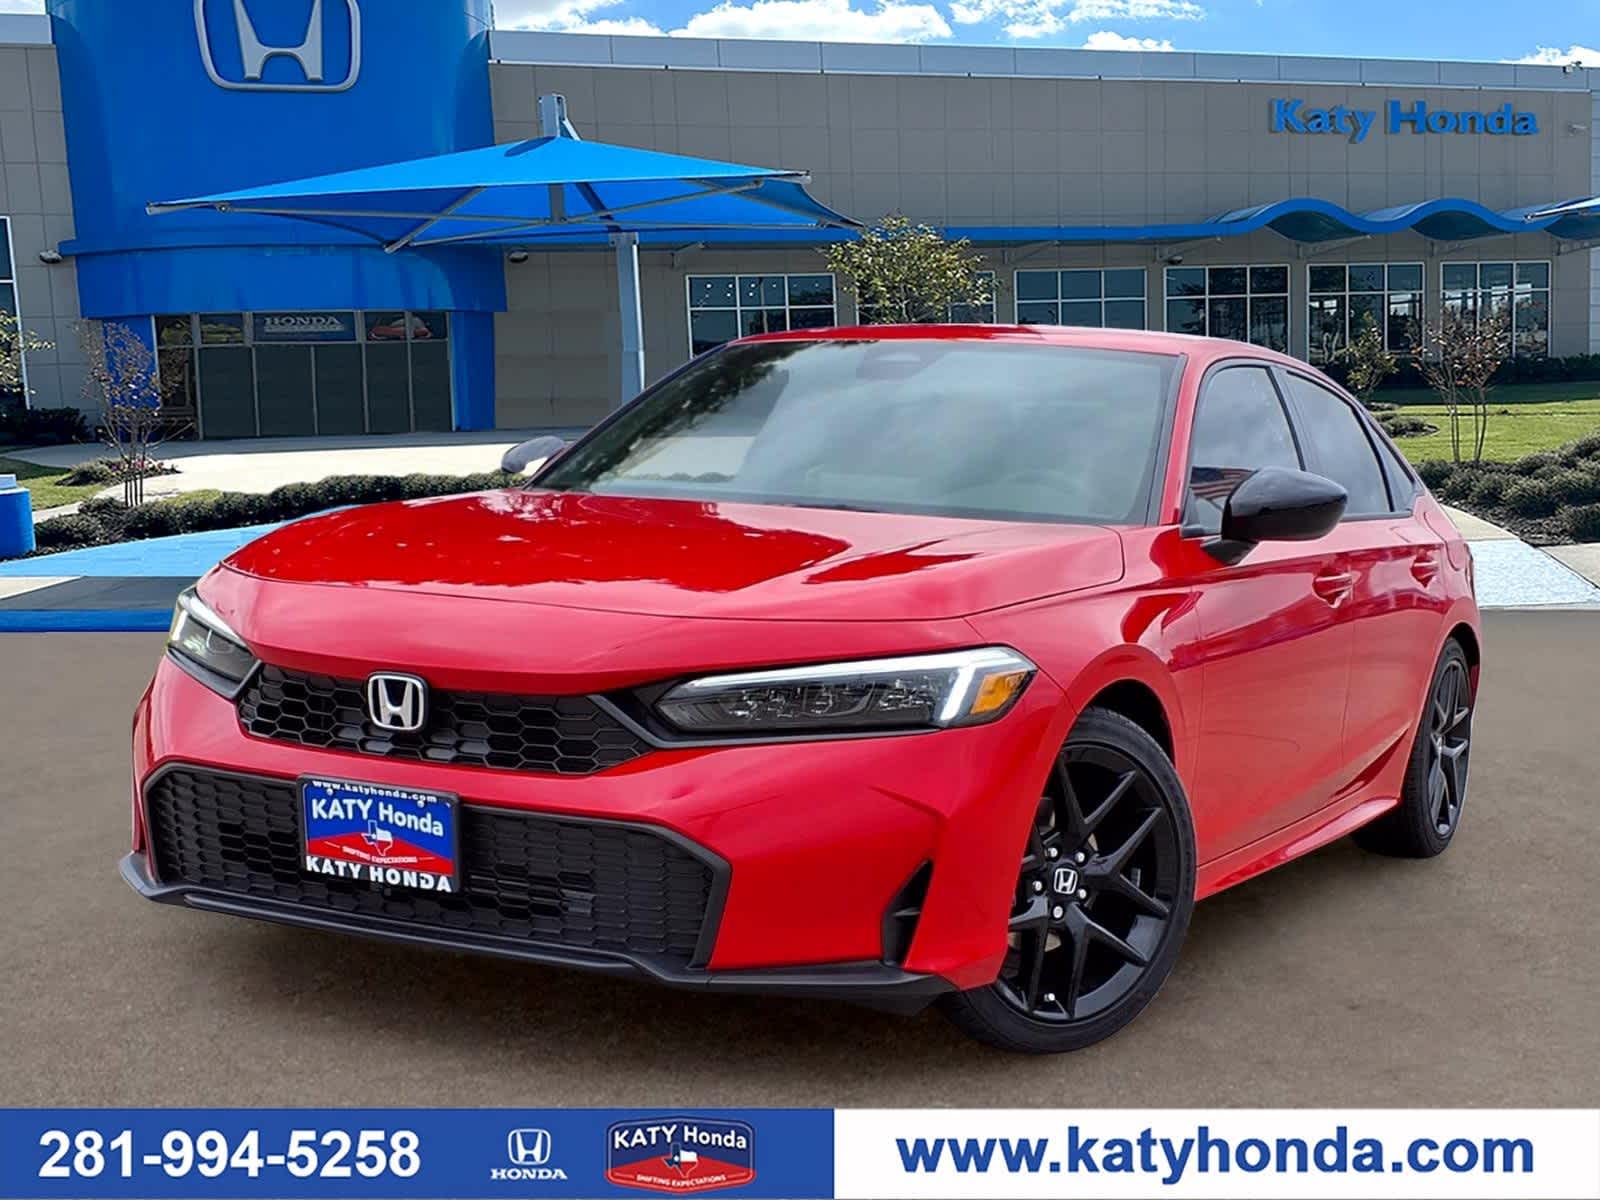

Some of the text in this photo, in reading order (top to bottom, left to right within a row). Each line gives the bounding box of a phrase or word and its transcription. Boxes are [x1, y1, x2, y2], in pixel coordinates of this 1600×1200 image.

[1270, 99, 1538, 144] Katy Honda
[311, 798, 444, 837] KATY Honda
[305, 855, 452, 892] KATY HONDA
